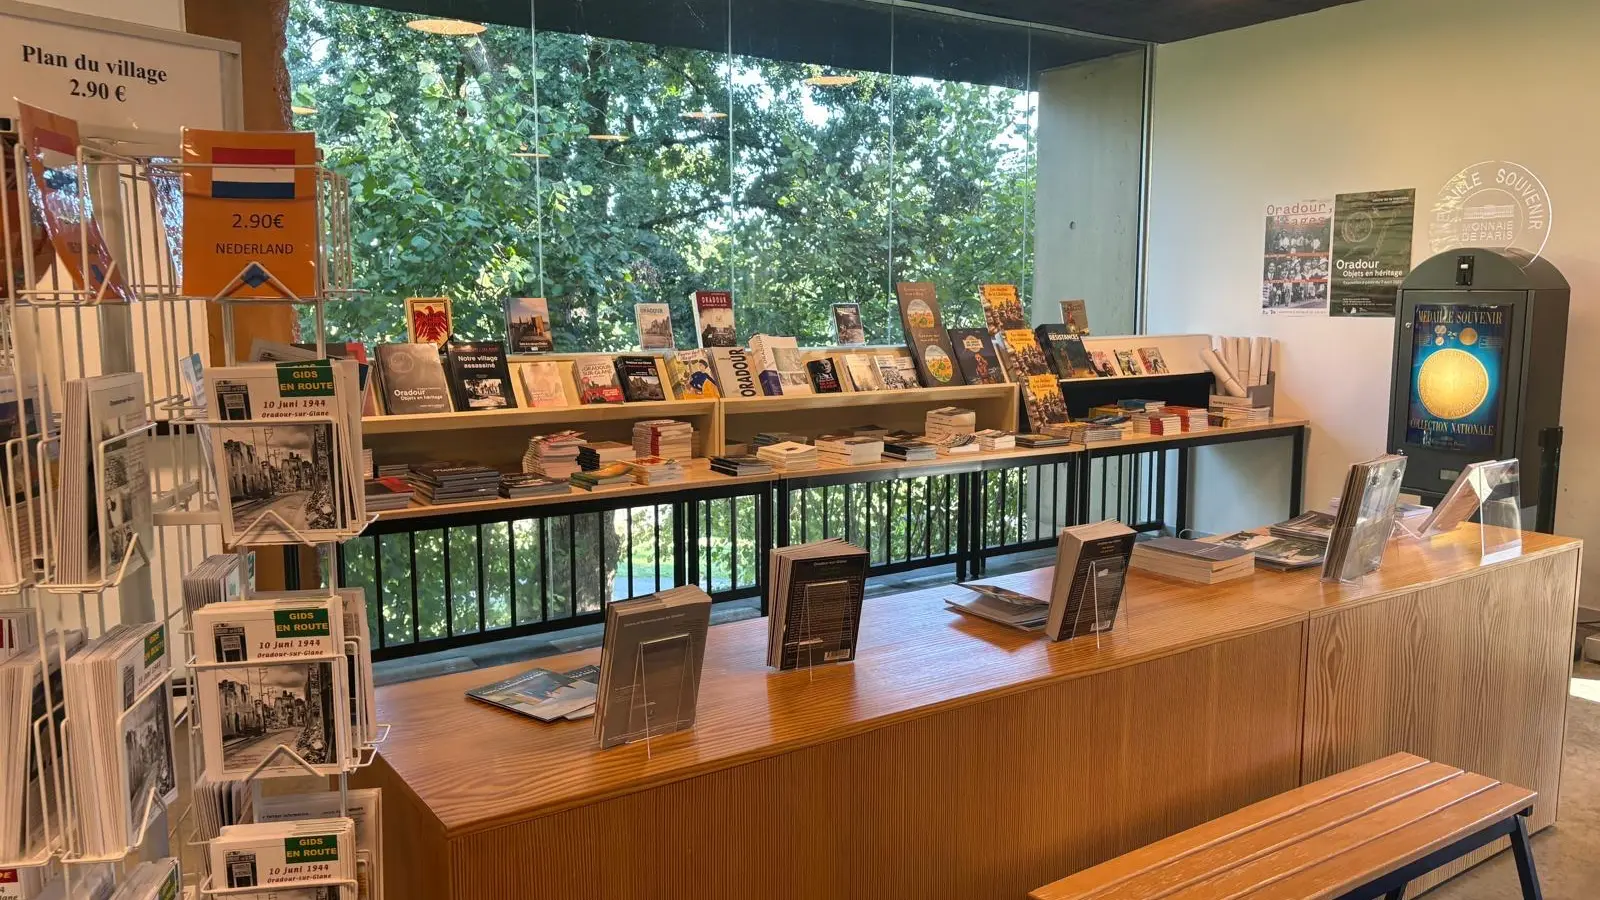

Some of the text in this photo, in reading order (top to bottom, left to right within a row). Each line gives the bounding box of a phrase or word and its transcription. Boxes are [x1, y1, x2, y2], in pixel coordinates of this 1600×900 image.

[22, 44, 168, 85] Plan du village
[69, 79, 127, 102] 2.90 €
[1495, 168, 1543, 230] SOUVENIR
[1266, 202, 1333, 216] Oradour,
[232, 213, 285, 229] 2.90€
[1462, 220, 1513, 231] MONNAIE
[1462, 230, 1513, 242] DE PARIS
[216, 243, 294, 256] NEDERLAND
[1336, 259, 1380, 270] Oradour
[1342, 270, 1364, 278] Objets
[1374, 269, 1403, 278] héritage
[701, 296, 727, 304] ORADOUR
[1456, 311, 1503, 325] SOUVENIR
[477, 355, 498, 363] village
[293, 370, 318, 378] GIDS
[729, 348, 757, 397] ORADOUR
[281, 382, 333, 391] EN ROUTE
[394, 389, 425, 397] Oradour
[263, 399, 326, 410] 10 juni 1944
[261, 410, 330, 419] Oradour-sur-Glane
[1410, 418, 1494, 436] COLLECTION NATIONALE
[289, 612, 314, 620] GIDS
[276, 622, 329, 632] EN ROUTE
[259, 639, 321, 650] 10 juni 1944
[257, 650, 324, 658] Oradour-sur-Glane
[299, 838, 323, 846] GIDS
[287, 847, 337, 858] EN ROUTE
[269, 864, 329, 876] 10 juni 1944
[267, 873, 332, 884] Oradour-sur-Glane
